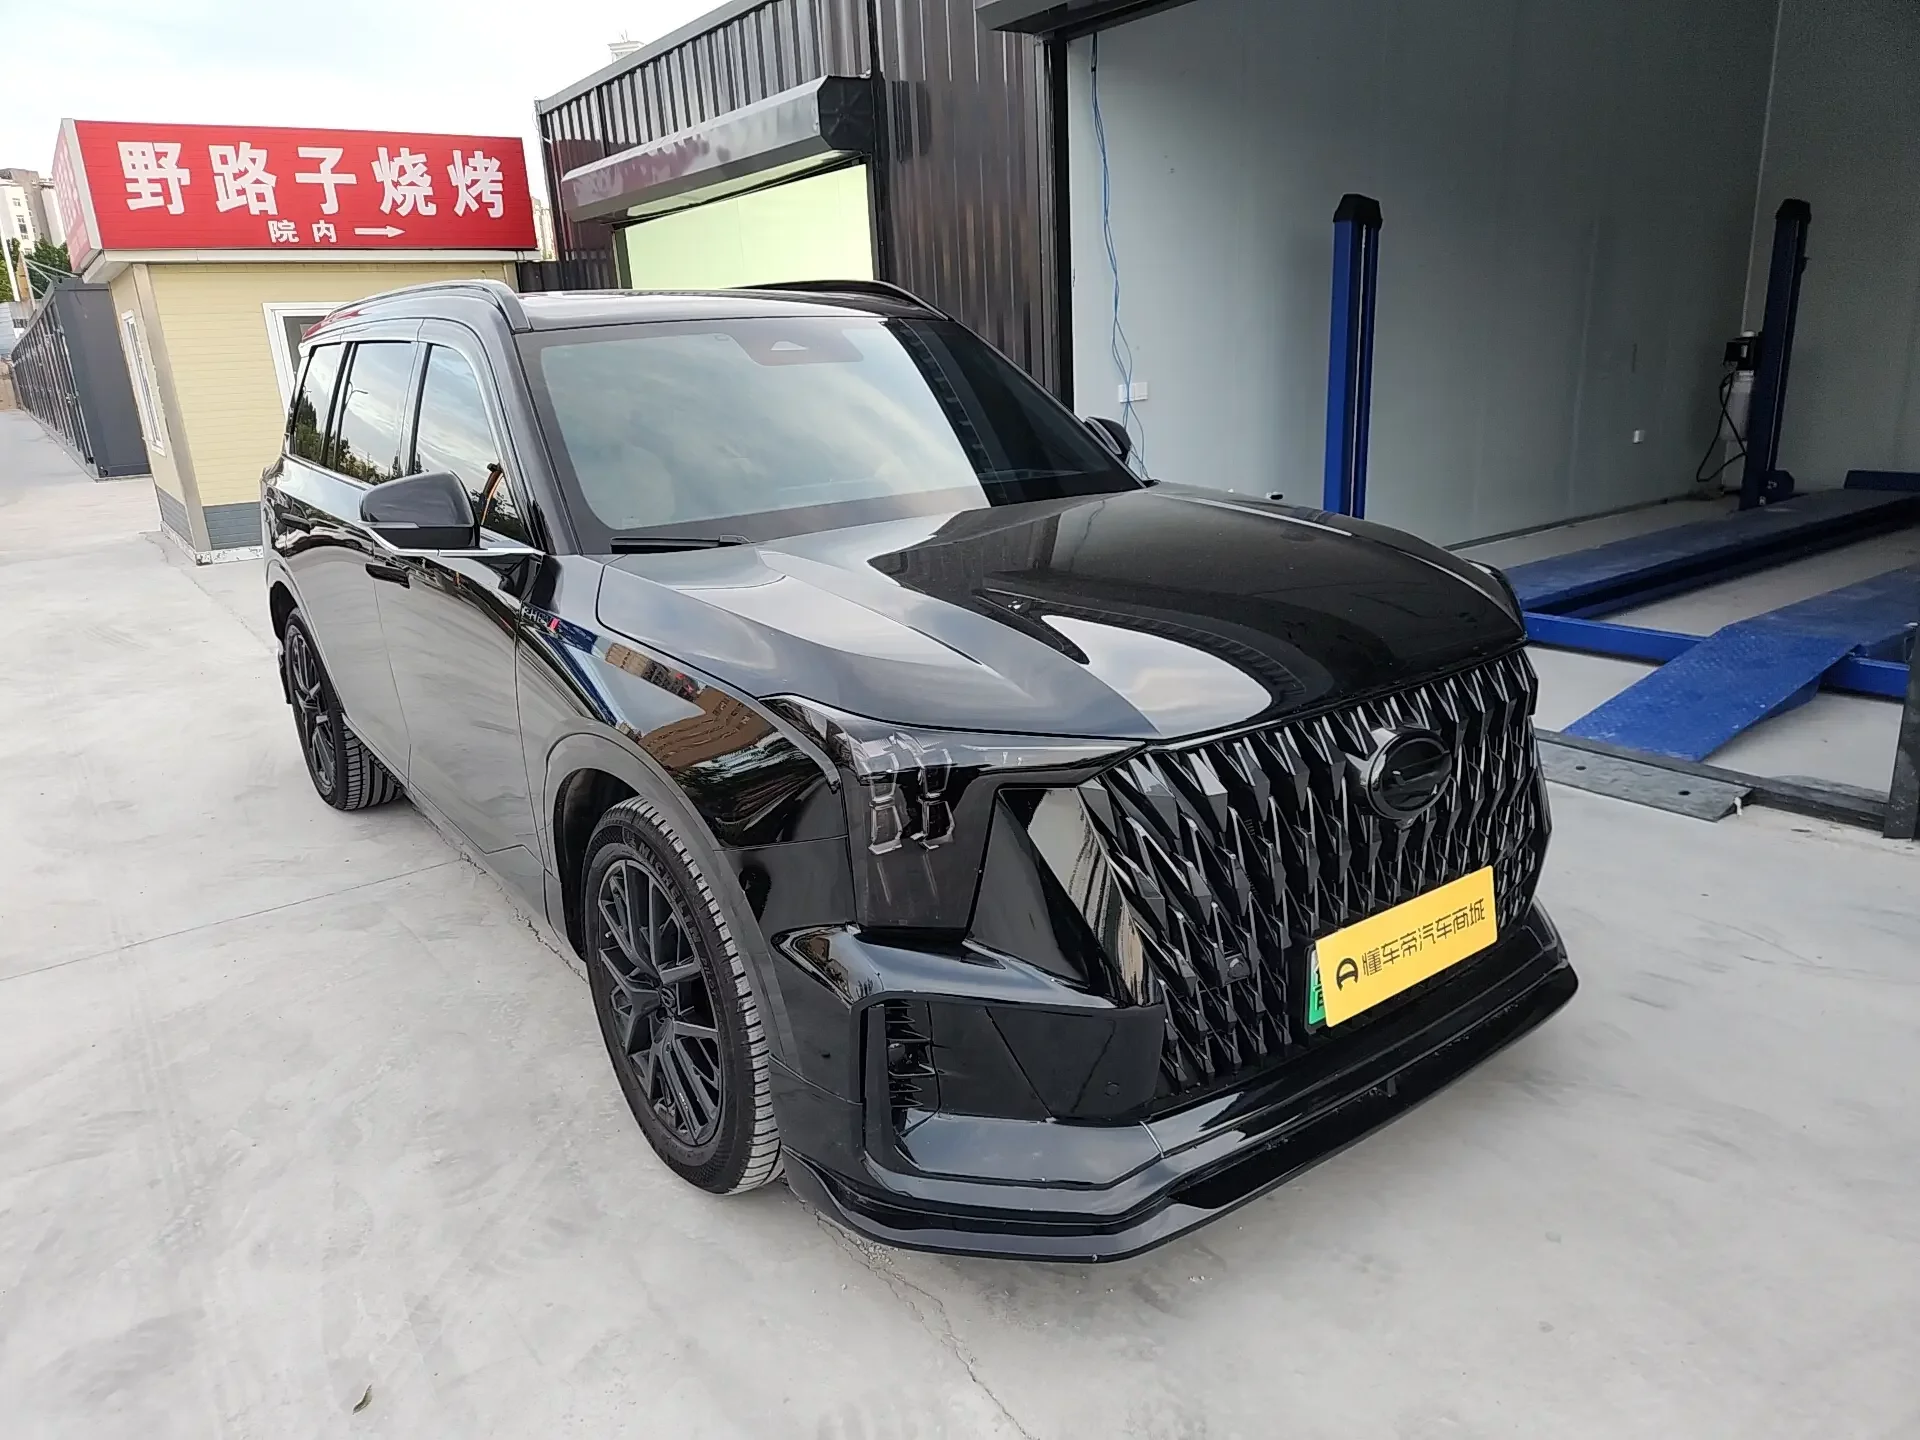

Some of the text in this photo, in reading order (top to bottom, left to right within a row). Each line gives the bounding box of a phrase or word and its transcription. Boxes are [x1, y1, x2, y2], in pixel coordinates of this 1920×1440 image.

[117, 141, 505, 218] 野路子烧烤
[268, 219, 338, 243] 院内
[638, 841, 702, 942] MICHELIN
